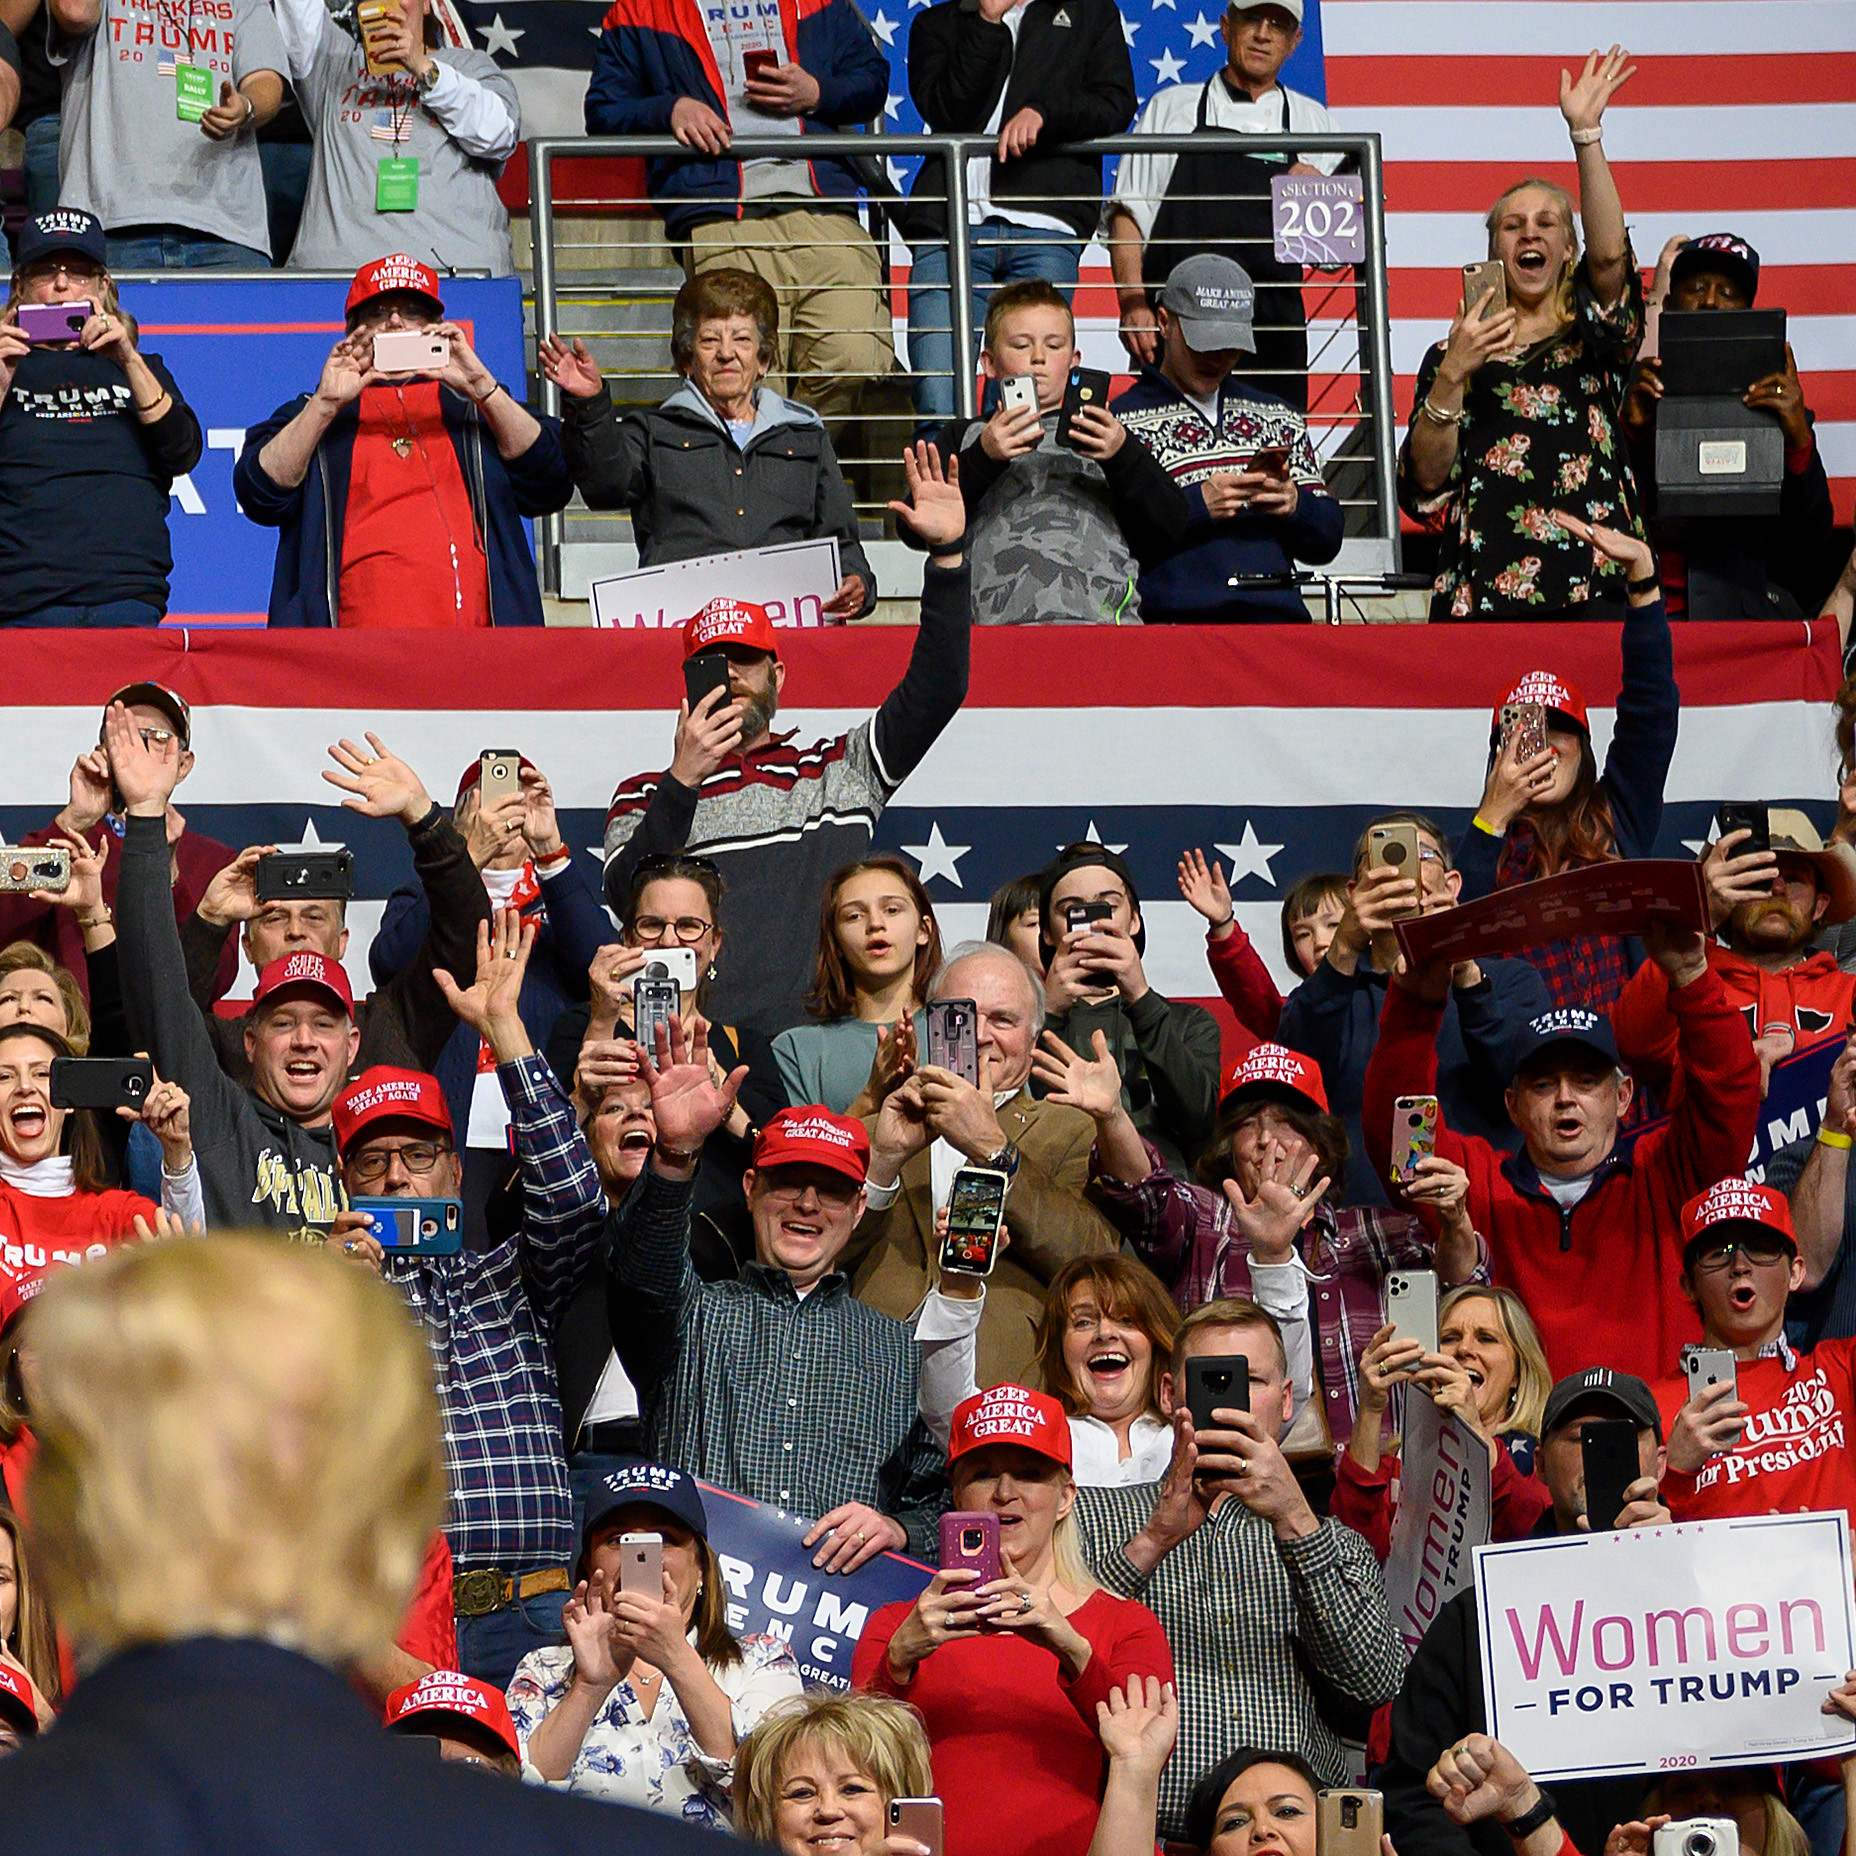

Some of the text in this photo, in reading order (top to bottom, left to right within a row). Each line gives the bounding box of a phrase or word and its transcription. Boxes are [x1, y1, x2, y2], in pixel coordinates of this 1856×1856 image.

[1286, 182, 1348, 198] SECTION
[1278, 200, 1359, 238] 202
[702, 598, 736, 617] KEEP
[690, 610, 752, 637] AMERICA
[697, 622, 745, 643] GREAT
[1708, 1178, 1753, 1198] KEEP
[1693, 1192, 1773, 1221] AMERICA
[1704, 1208, 1761, 1225] GREAT
[983, 1387, 1030, 1404] KEEP
[965, 1402, 1047, 1428] AMERICA
[972, 1418, 1034, 1437] GREAT
[1722, 1419, 1846, 1484] President
[1442, 1465, 1476, 1587] TRUMP
[1505, 1598, 1827, 1681] Women
[1547, 1667, 1800, 1717] FOR TRUMP
[1658, 1754, 1698, 1769] 2020
